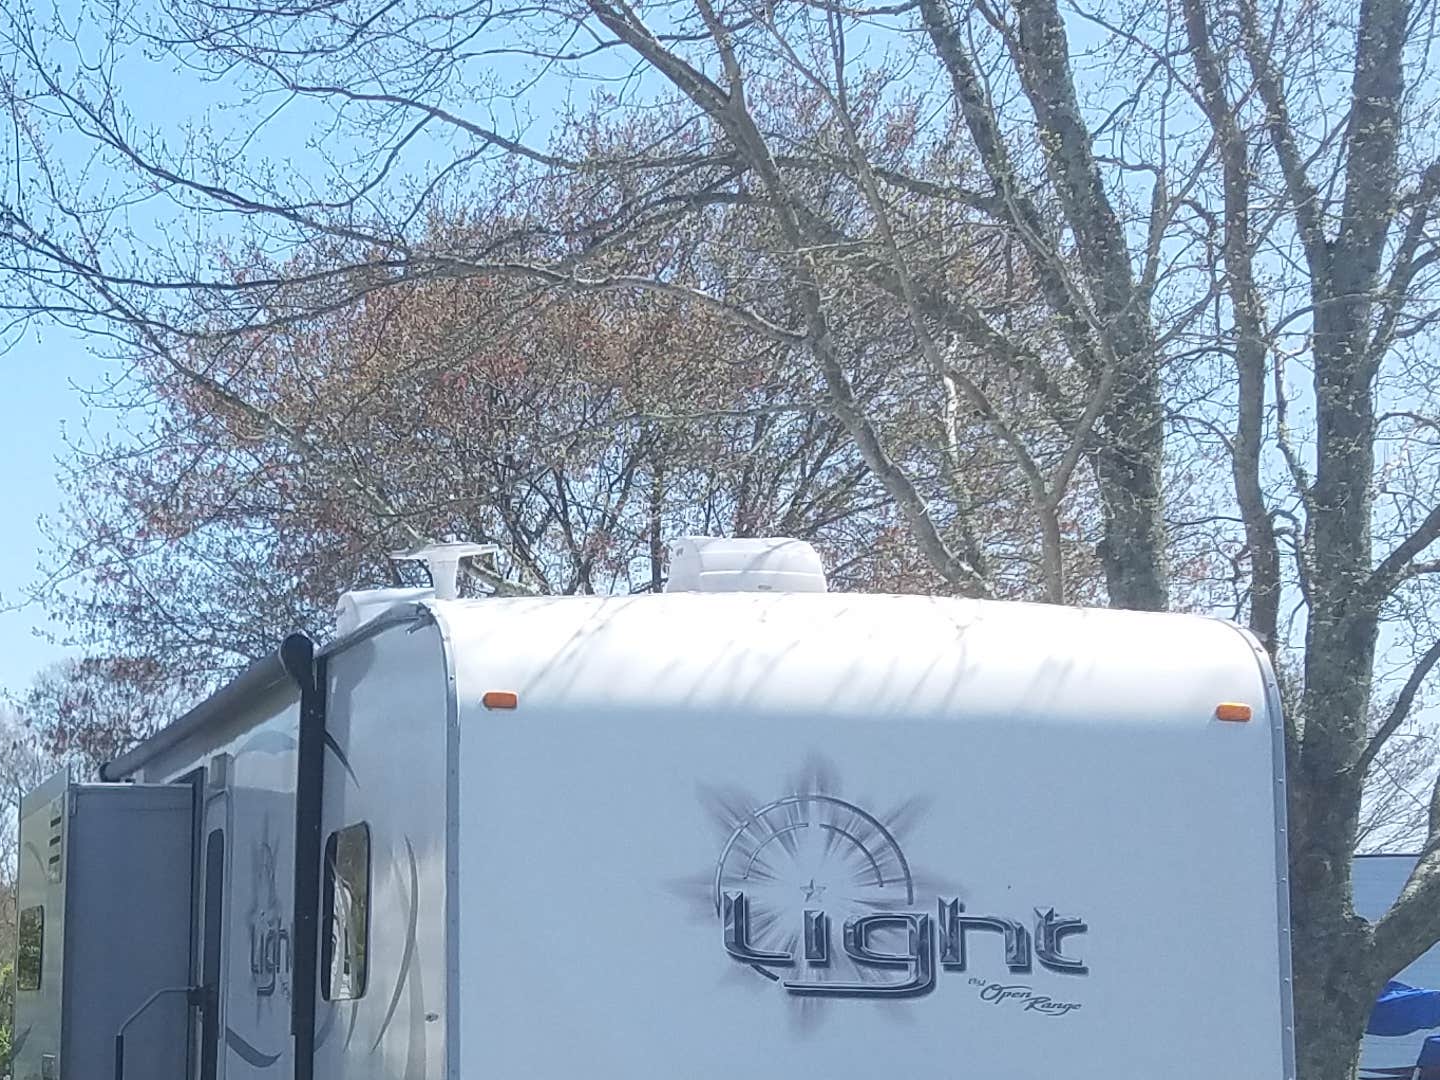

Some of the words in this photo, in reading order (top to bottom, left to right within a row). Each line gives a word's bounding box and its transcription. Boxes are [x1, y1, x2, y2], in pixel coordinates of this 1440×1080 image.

[720, 888, 1089, 997] Light
[980, 984, 1033, 1005] Open
[1020, 996, 1082, 1016] Range
